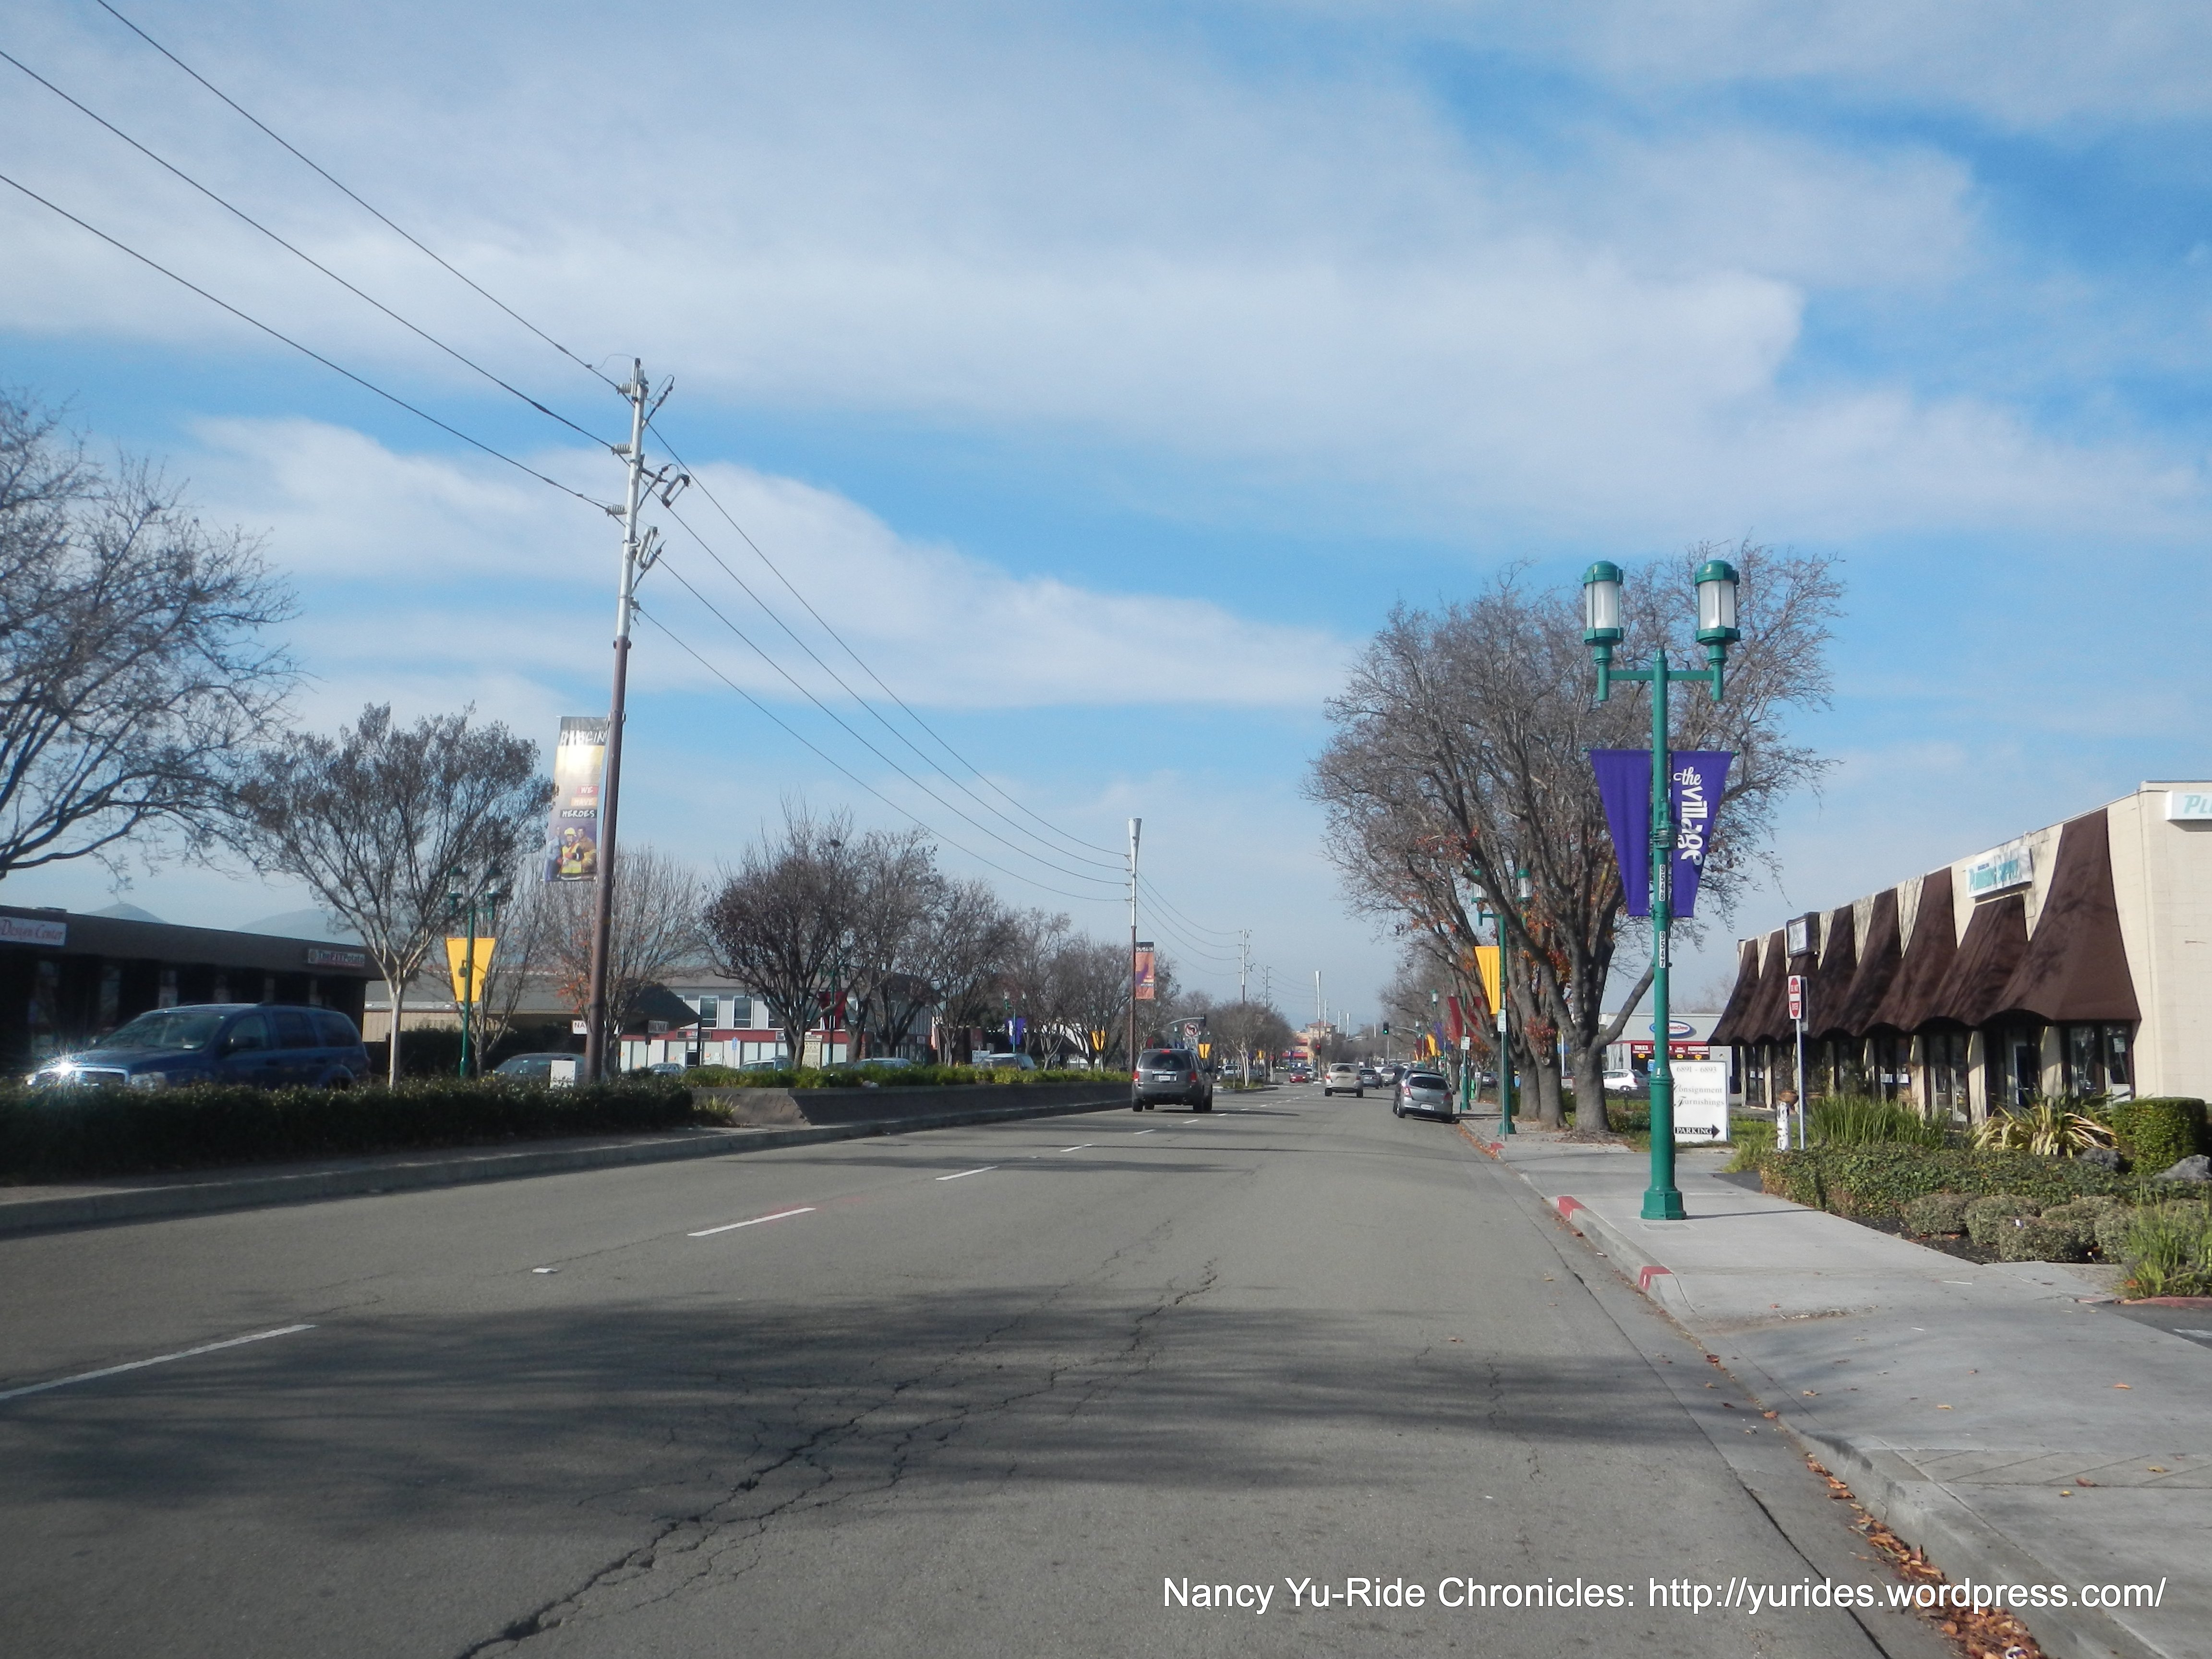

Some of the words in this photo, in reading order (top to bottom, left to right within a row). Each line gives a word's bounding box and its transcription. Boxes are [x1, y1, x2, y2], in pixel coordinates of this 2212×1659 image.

[1673, 767, 1702, 786] the
[575, 797, 594, 806] HAVE
[562, 809, 595, 818] HEROES
[1677, 786, 1708, 866] village
[1674, 1083, 1722, 1094] Consignment
[1673, 1096, 1724, 1107] Furnishings
